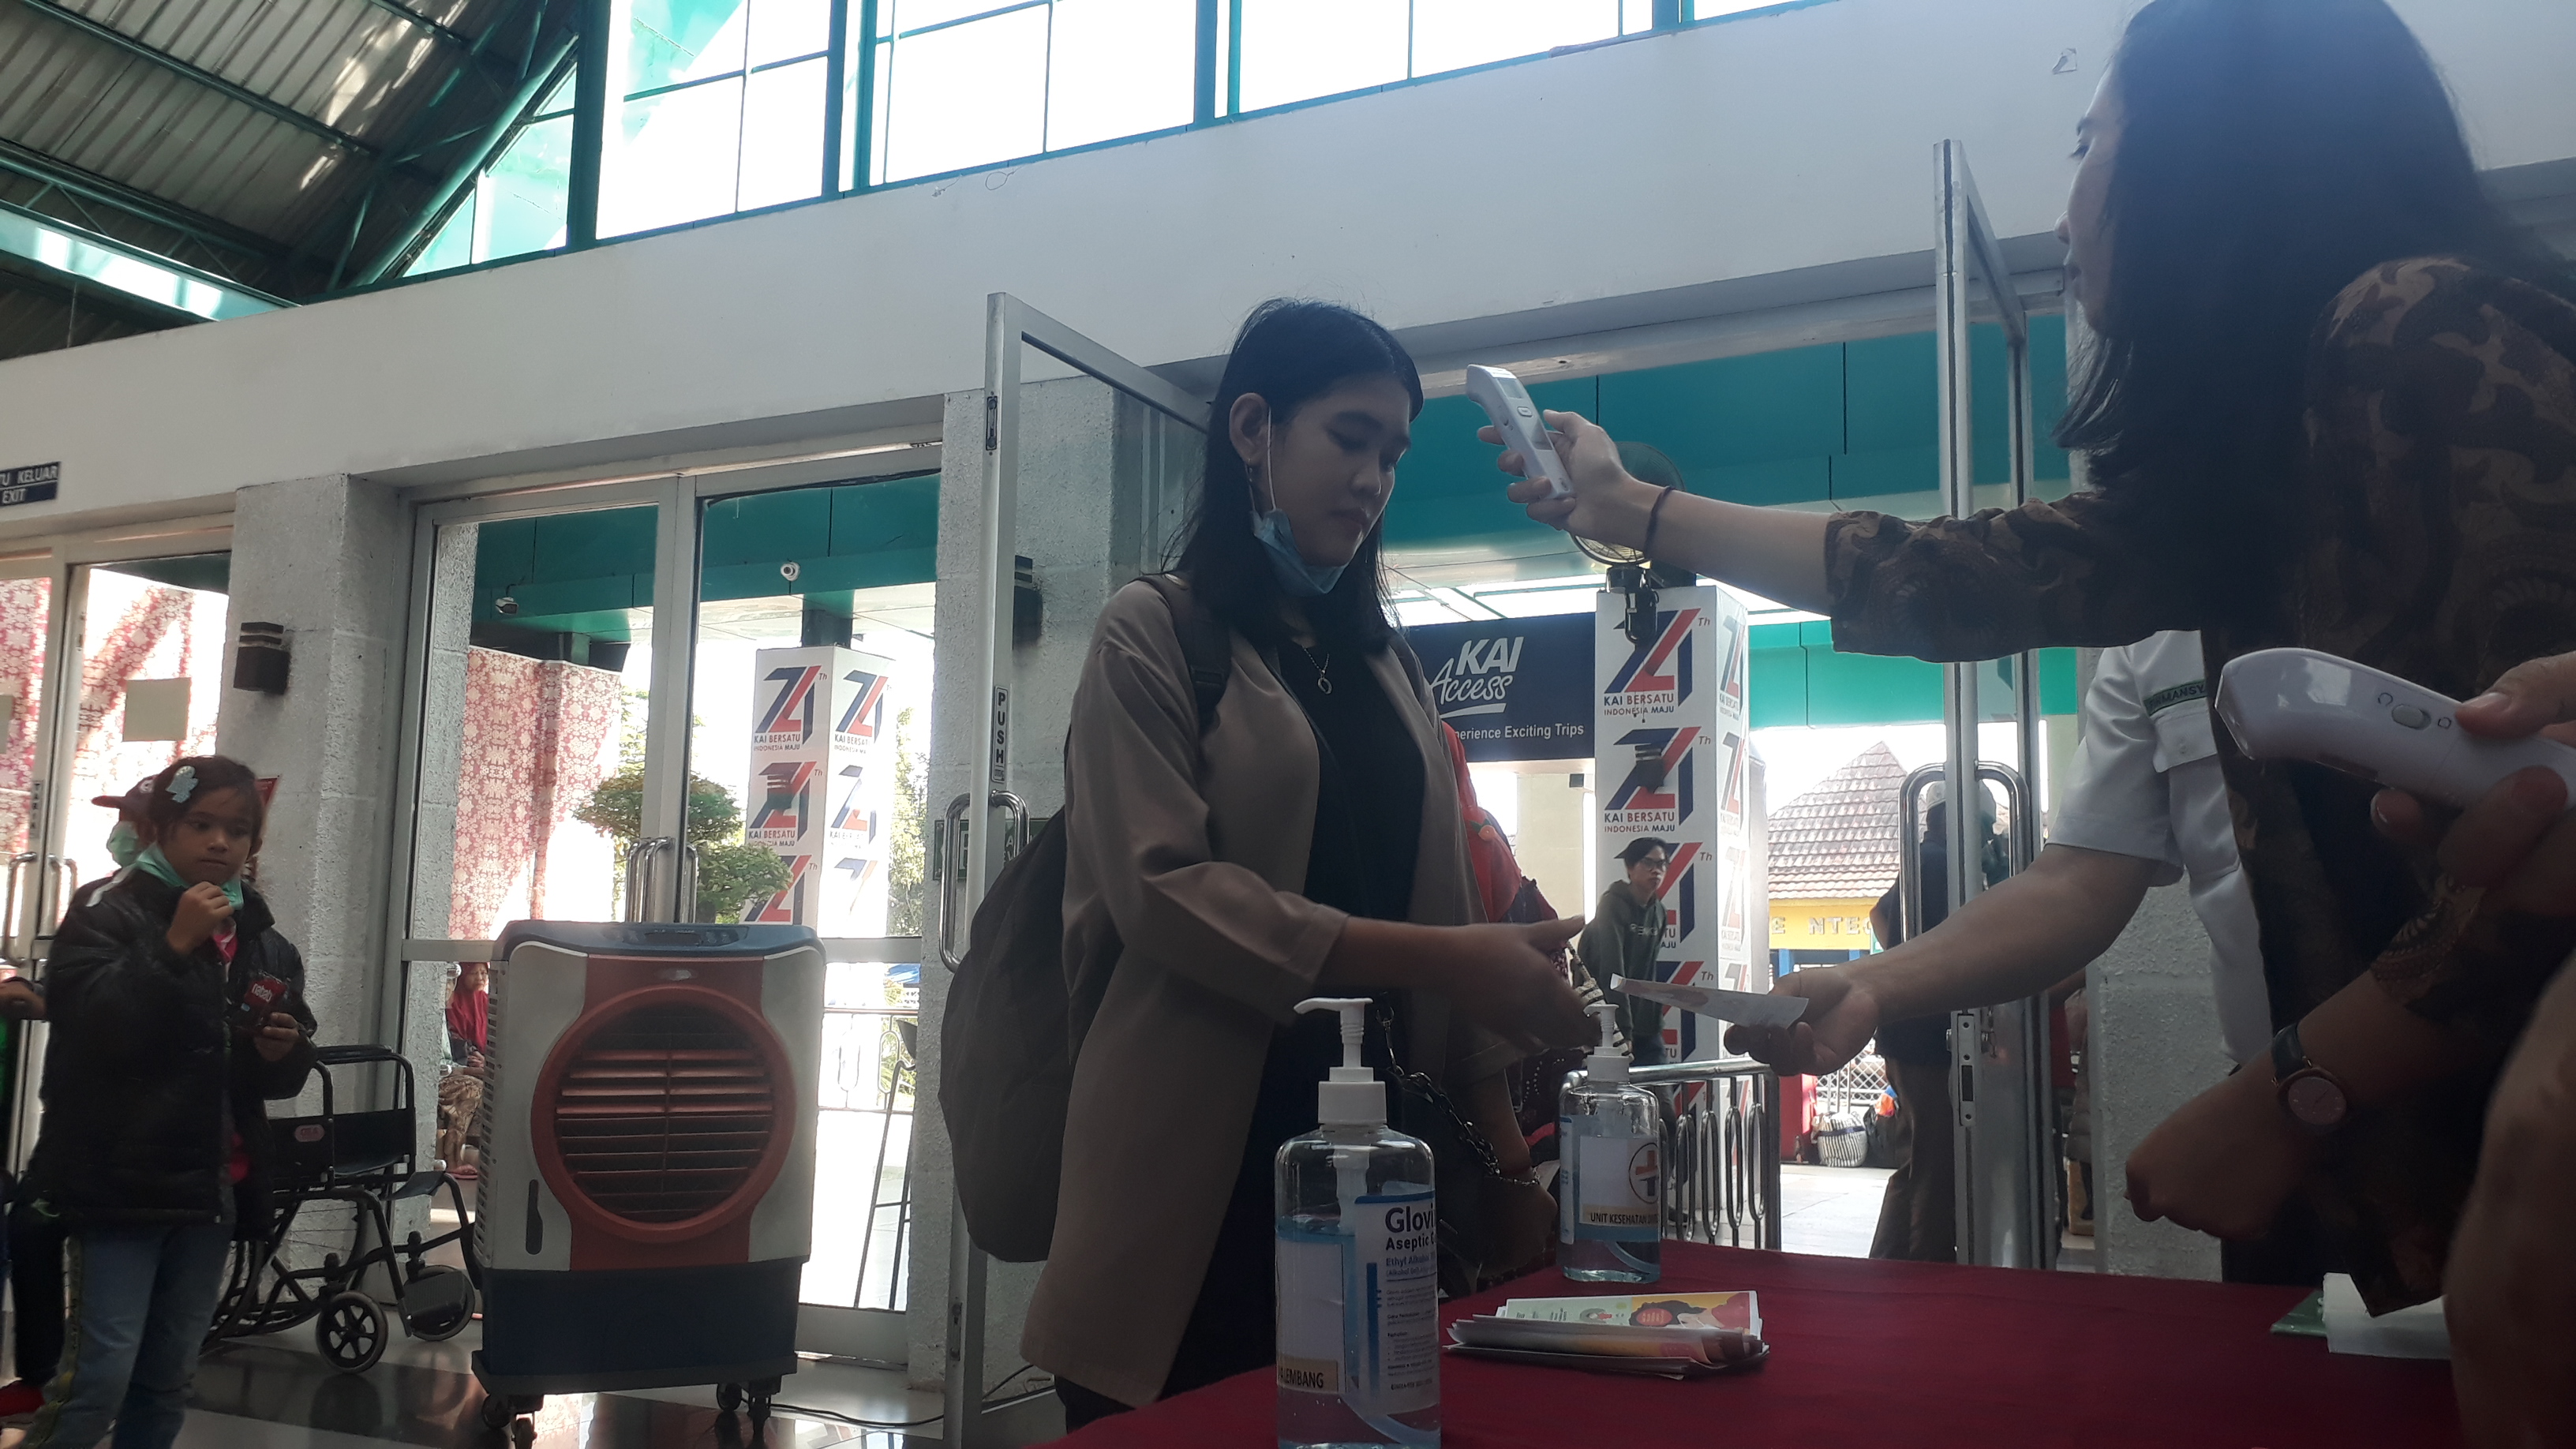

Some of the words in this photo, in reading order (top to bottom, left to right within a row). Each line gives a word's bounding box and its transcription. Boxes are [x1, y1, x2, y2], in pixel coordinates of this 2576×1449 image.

[17, 465, 58, 484] KELUAR
[2, 488, 26, 504] EXIT
[1698, 617, 1710, 627] Th
[1455, 635, 1525, 676] KAI
[1432, 657, 1514, 706] Access
[1604, 694, 1623, 706] KAI
[1627, 693, 1674, 706] BERSATU
[1604, 707, 1649, 716] INDONESIA
[995, 691, 1006, 764] PUSH
[1504, 723, 1552, 740] Exciting
[1555, 723, 1585, 739] Trips
[754, 735, 767, 744] KAI
[769, 733, 801, 743] BERSATU
[834, 734, 846, 743] KAI
[1698, 736, 1711, 746] Th
[1604, 812, 1623, 823] KAI
[1627, 811, 1675, 823] BERSATU
[748, 830, 762, 839] KAI
[763, 829, 796, 839] BERSATU
[1604, 824, 1649, 833] INDONESIA
[1651, 824, 1676, 833] MAJU
[1699, 852, 1713, 862] Th
[1701, 971, 1714, 981] Th
[1590, 1212, 1608, 1223] UNIT
[1609, 1214, 1647, 1225] KESEHATAN
[1386, 1233, 1429, 1252] Aseptic
